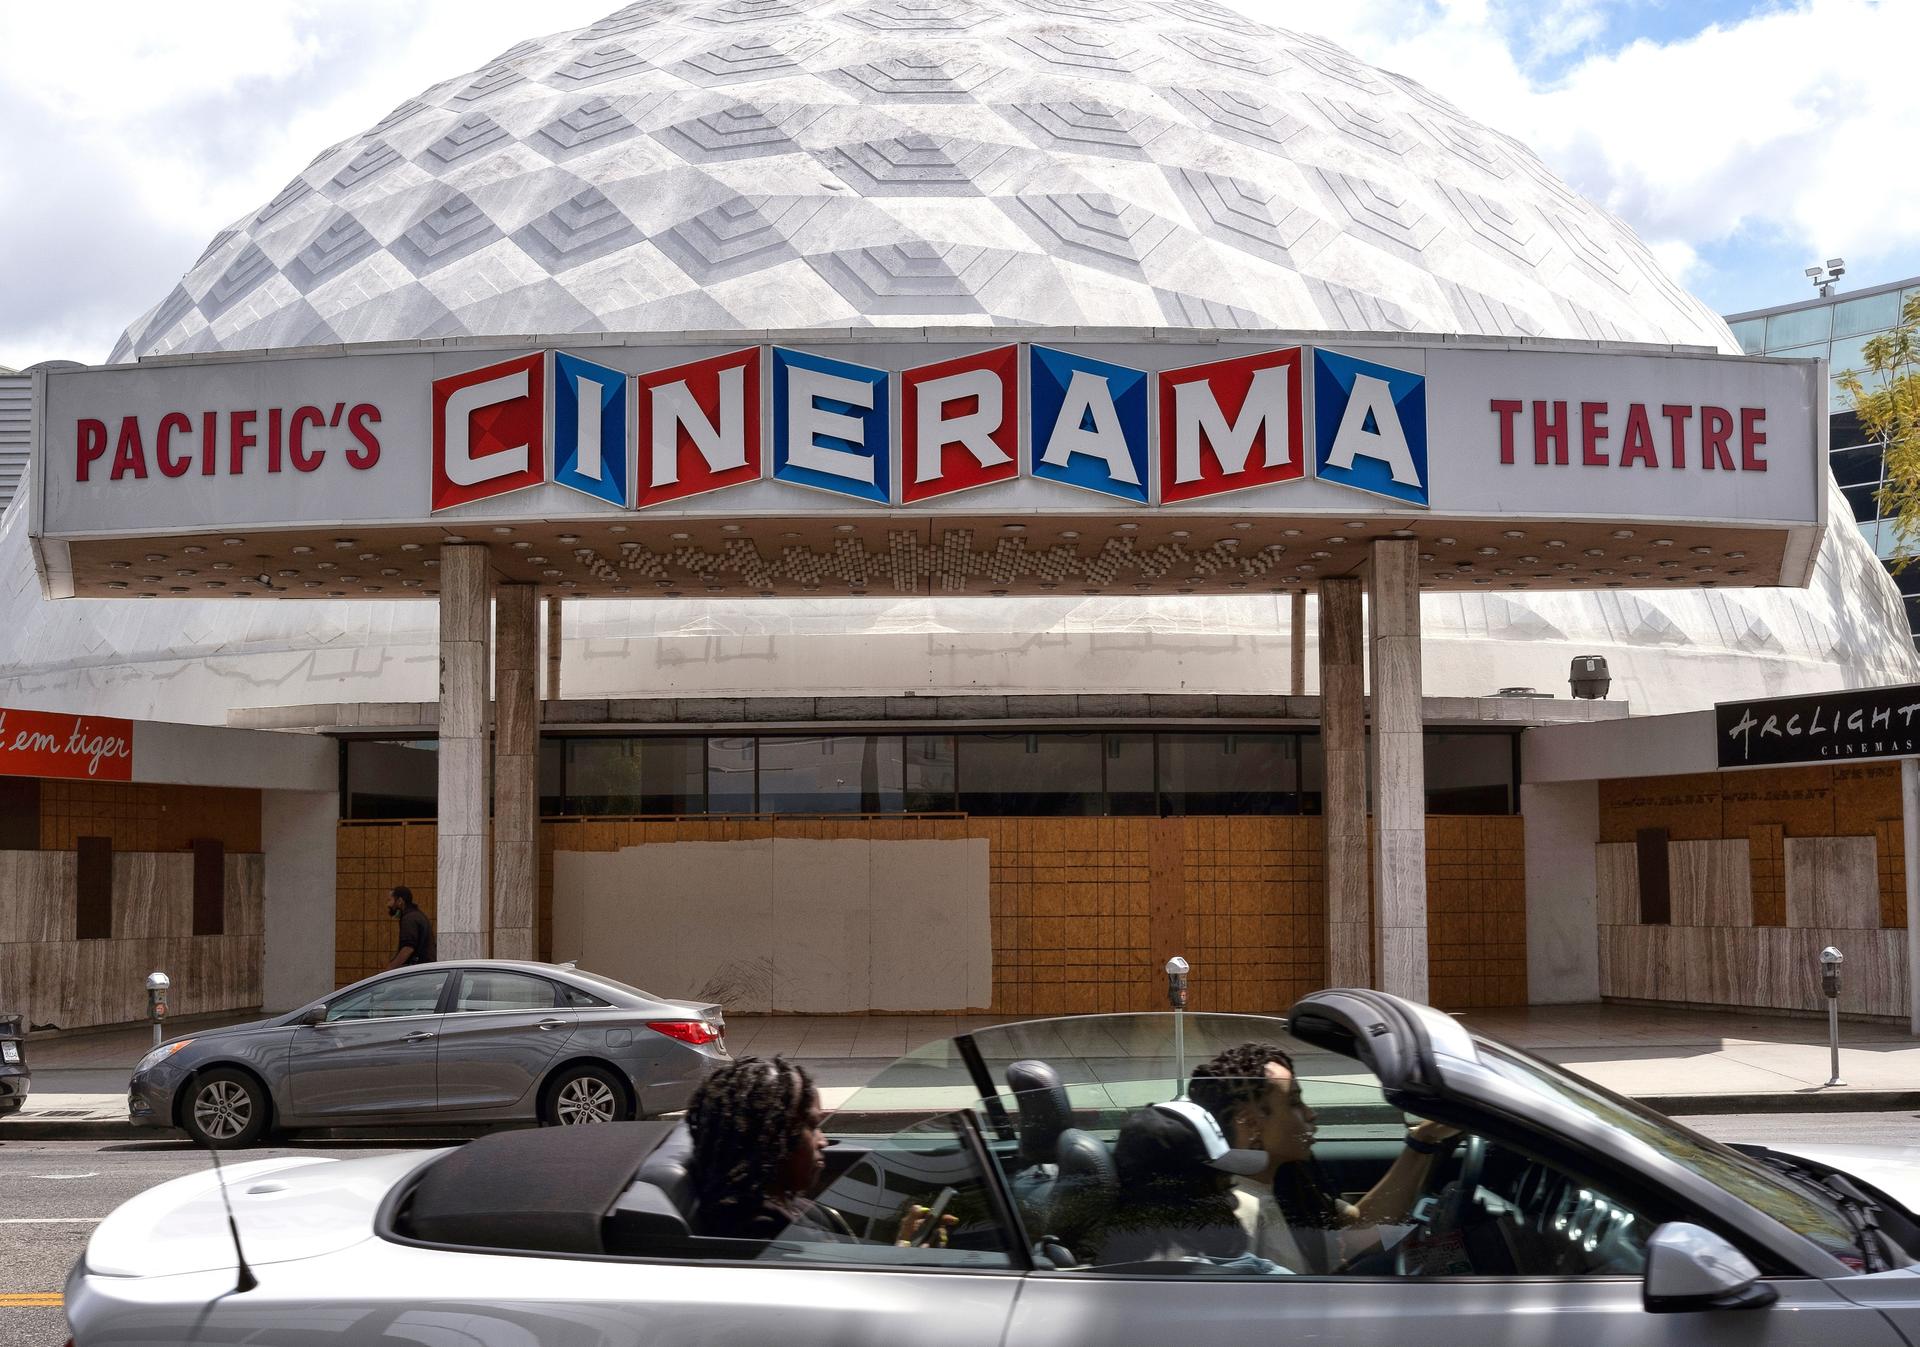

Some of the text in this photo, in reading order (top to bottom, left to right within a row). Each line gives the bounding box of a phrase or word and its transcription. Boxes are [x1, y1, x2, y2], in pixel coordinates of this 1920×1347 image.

[76, 363, 1767, 488] PACIFIC'S CINERAMA THEATRE
[9, 716, 130, 776] em tiger
[1821, 739, 1912, 756] CINEMAS
